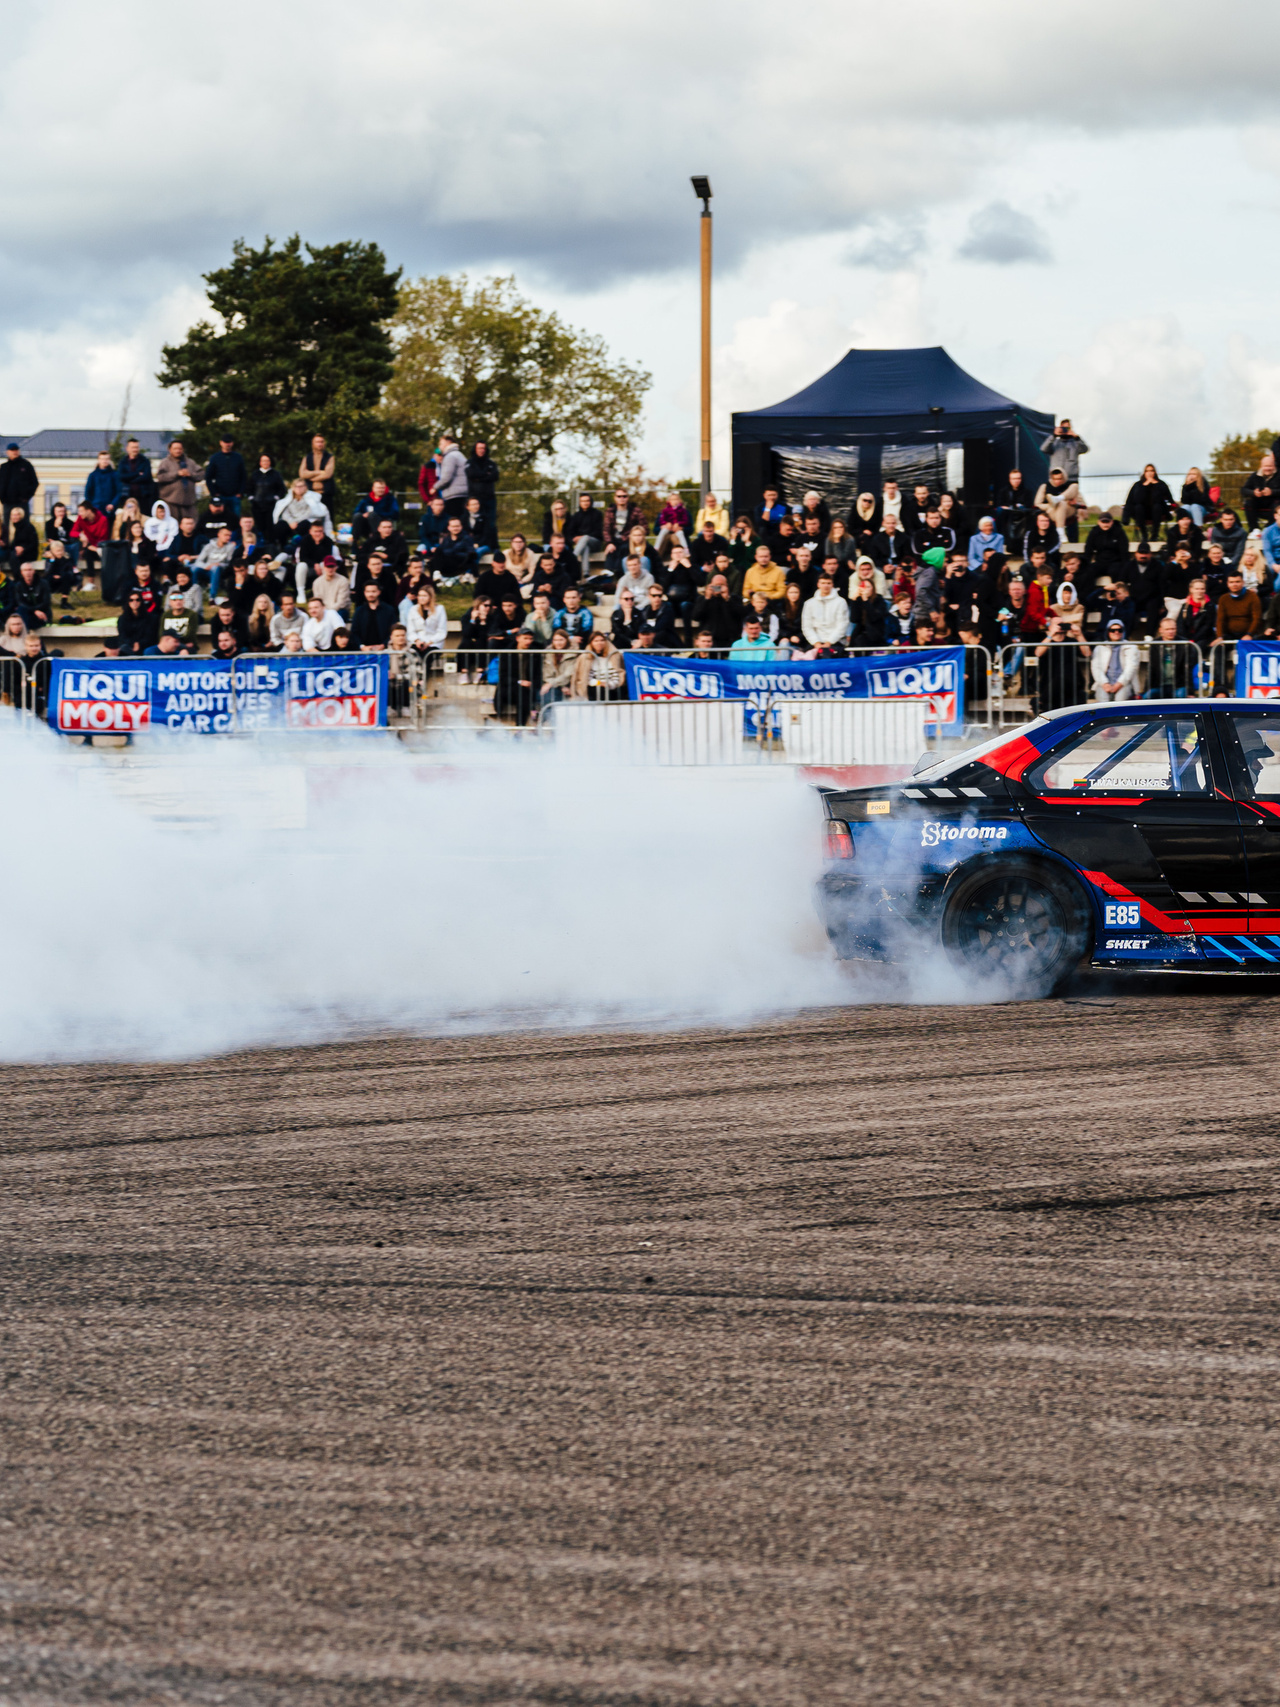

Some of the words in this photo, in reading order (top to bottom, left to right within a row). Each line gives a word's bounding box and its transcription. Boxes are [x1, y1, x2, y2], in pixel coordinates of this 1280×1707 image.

[64, 673, 147, 701] LIQUI
[157, 671, 230, 691] MOTOR
[234, 671, 279, 690] OILS
[289, 668, 374, 697] LIQUI
[639, 669, 719, 698] LIQUI
[736, 674, 805, 691] MOTOR
[809, 672, 852, 690] OILS
[873, 664, 952, 694] LIQUI
[62, 702, 149, 729] MOLY
[167, 714, 210, 732] CAR
[290, 698, 376, 726] MOLY
[922, 822, 1007, 845] Storoma
[1105, 905, 1140, 925] E85
[1105, 939, 1150, 949] SHKET
